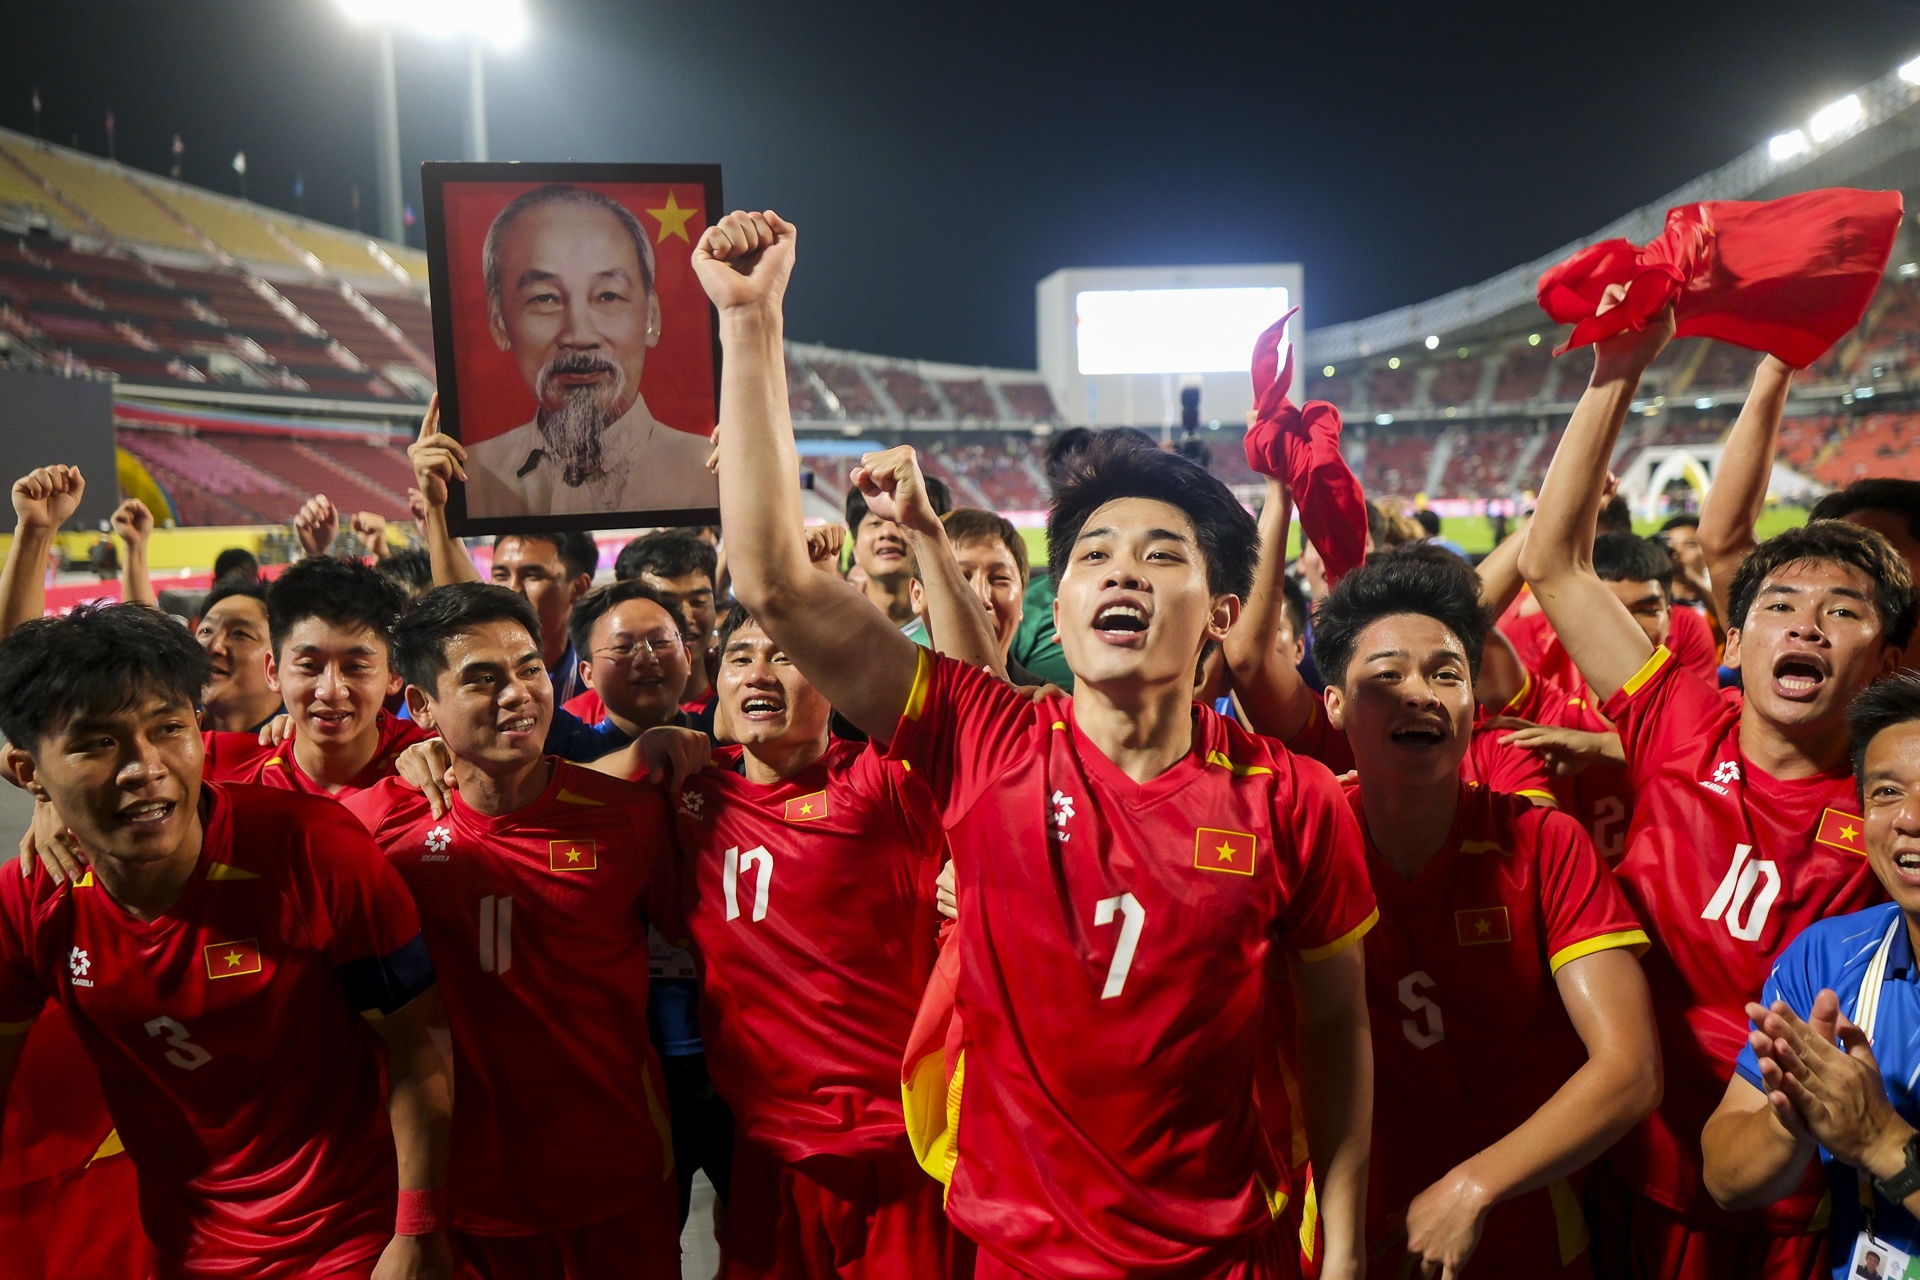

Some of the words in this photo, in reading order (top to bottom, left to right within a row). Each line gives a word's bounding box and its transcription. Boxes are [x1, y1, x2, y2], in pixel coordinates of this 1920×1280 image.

[1594, 796, 1625, 857] 2
[723, 845, 774, 923] 17
[1700, 843, 1781, 942] 10
[480, 894, 513, 976] 11
[1094, 892, 1146, 1000] 7
[144, 1015, 213, 1071] 3
